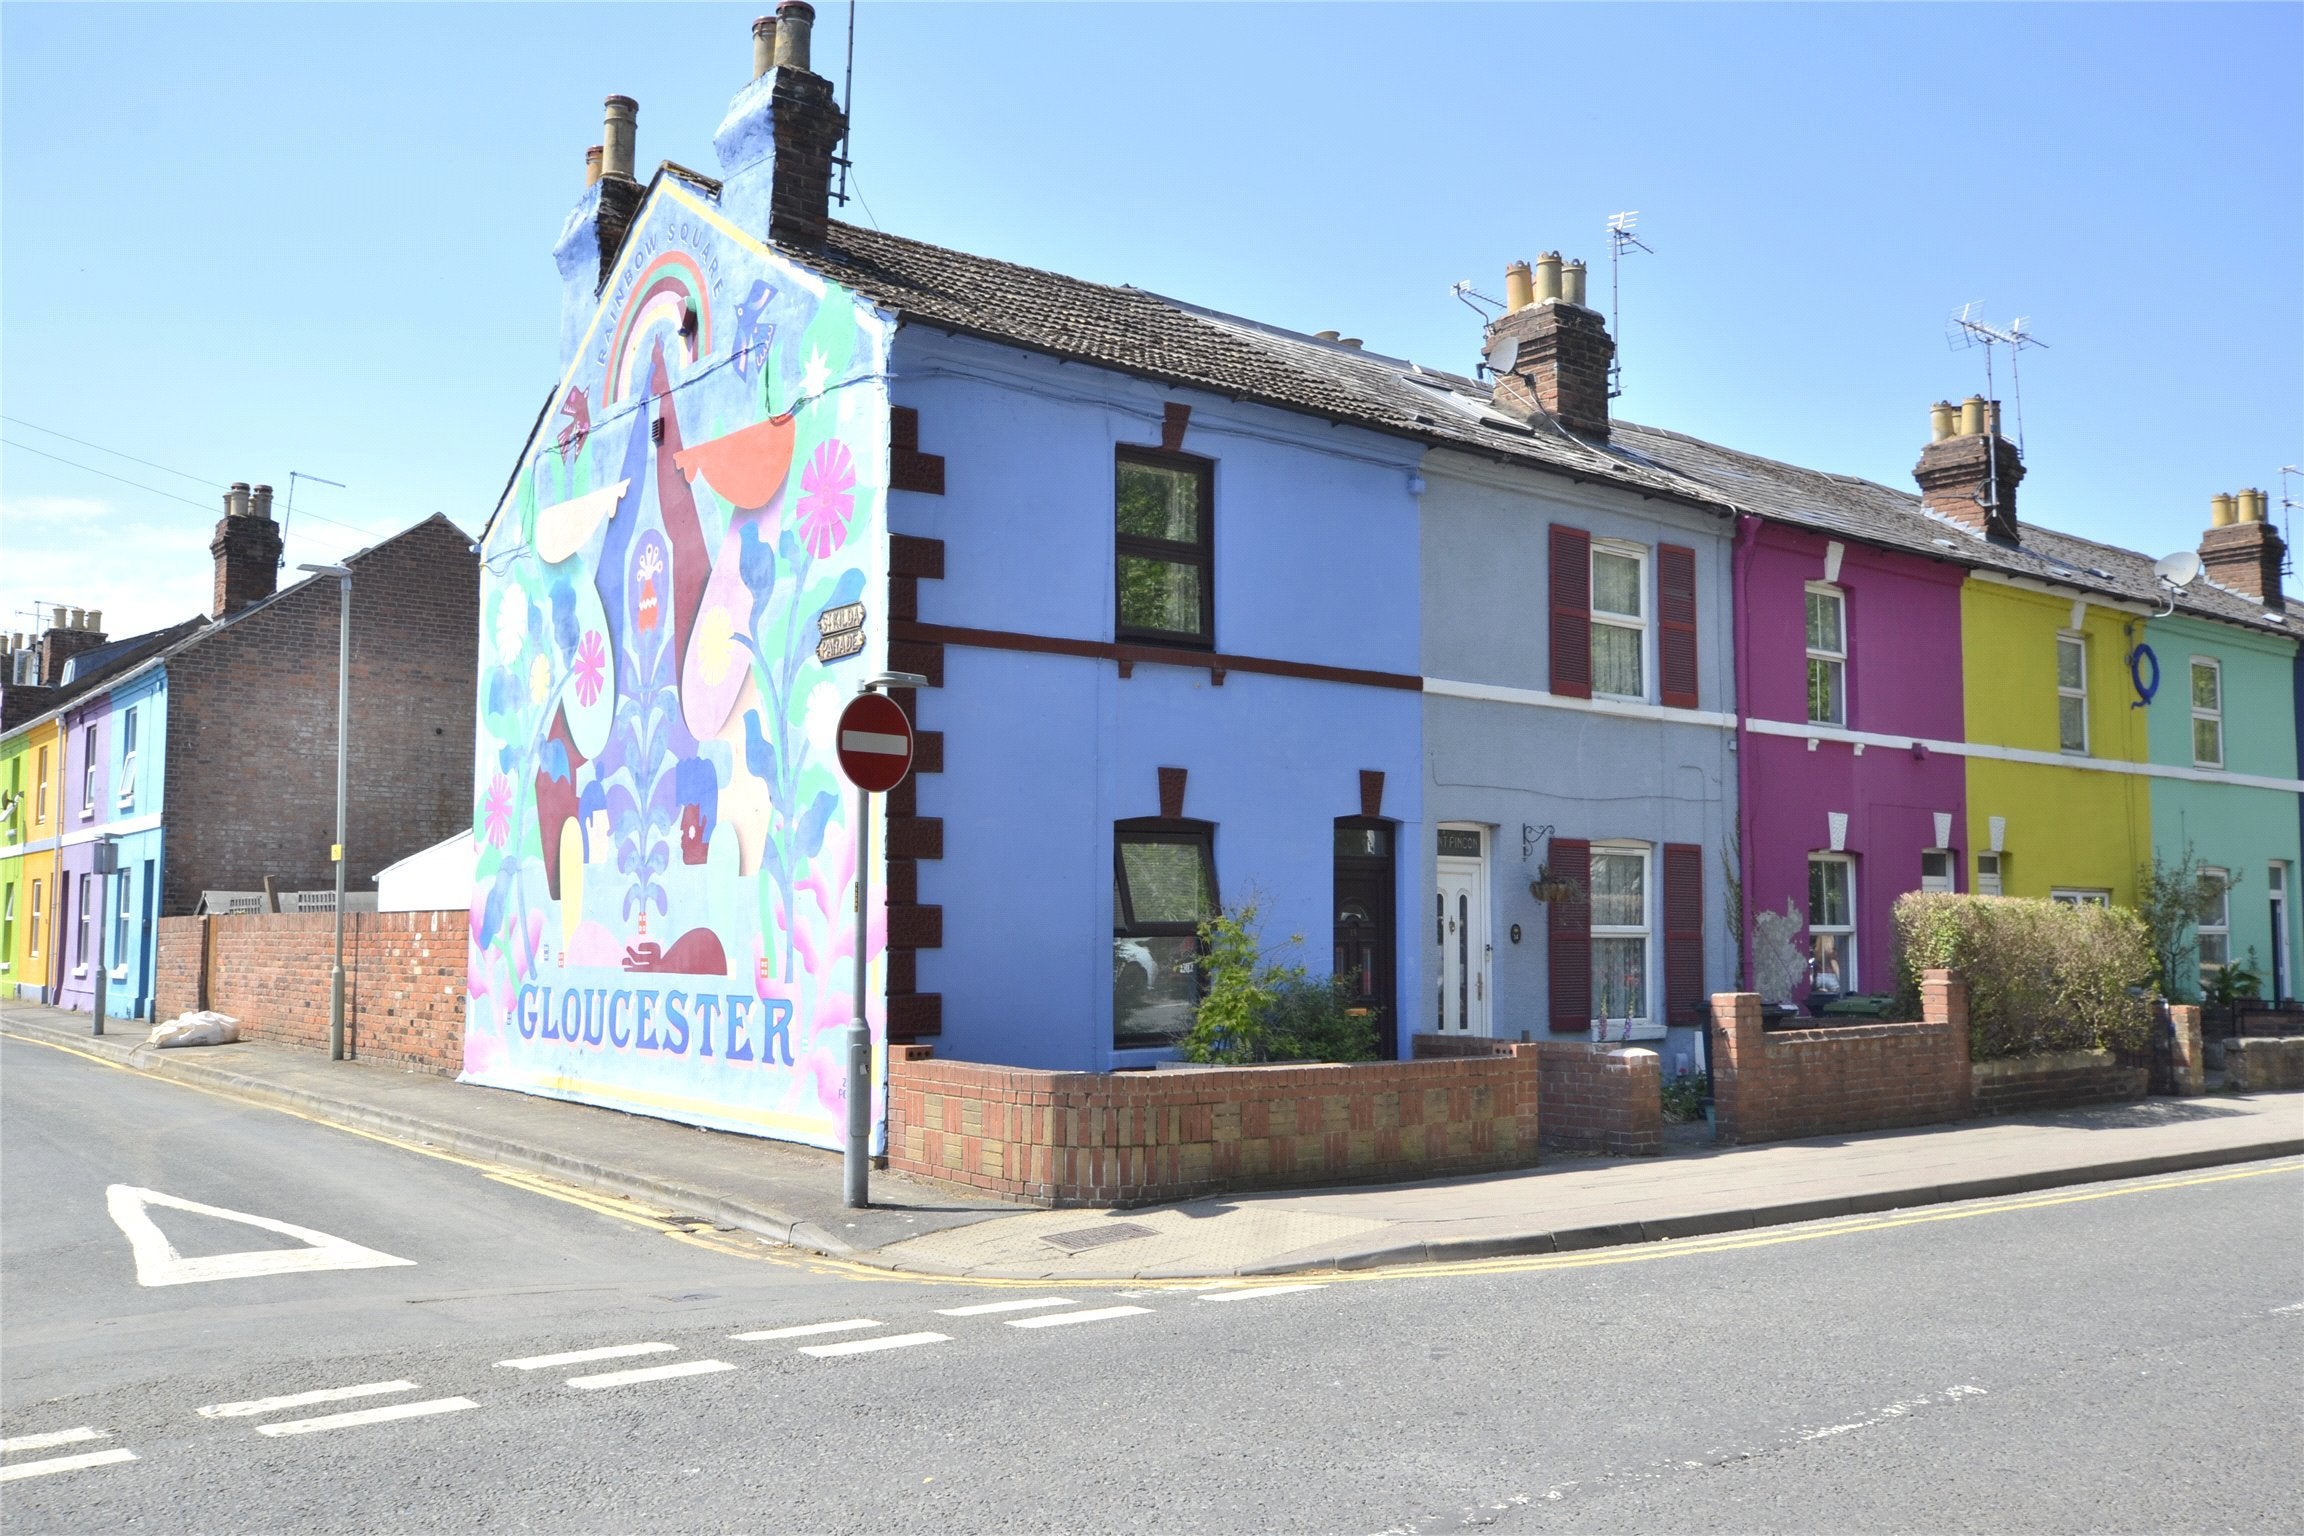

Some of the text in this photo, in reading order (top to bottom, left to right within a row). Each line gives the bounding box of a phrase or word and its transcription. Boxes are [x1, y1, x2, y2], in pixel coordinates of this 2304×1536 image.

[596, 223, 724, 367] RAINBOW SQUARE
[821, 634, 859, 658] PARADE
[517, 983, 796, 1067] GLOUCESTER
